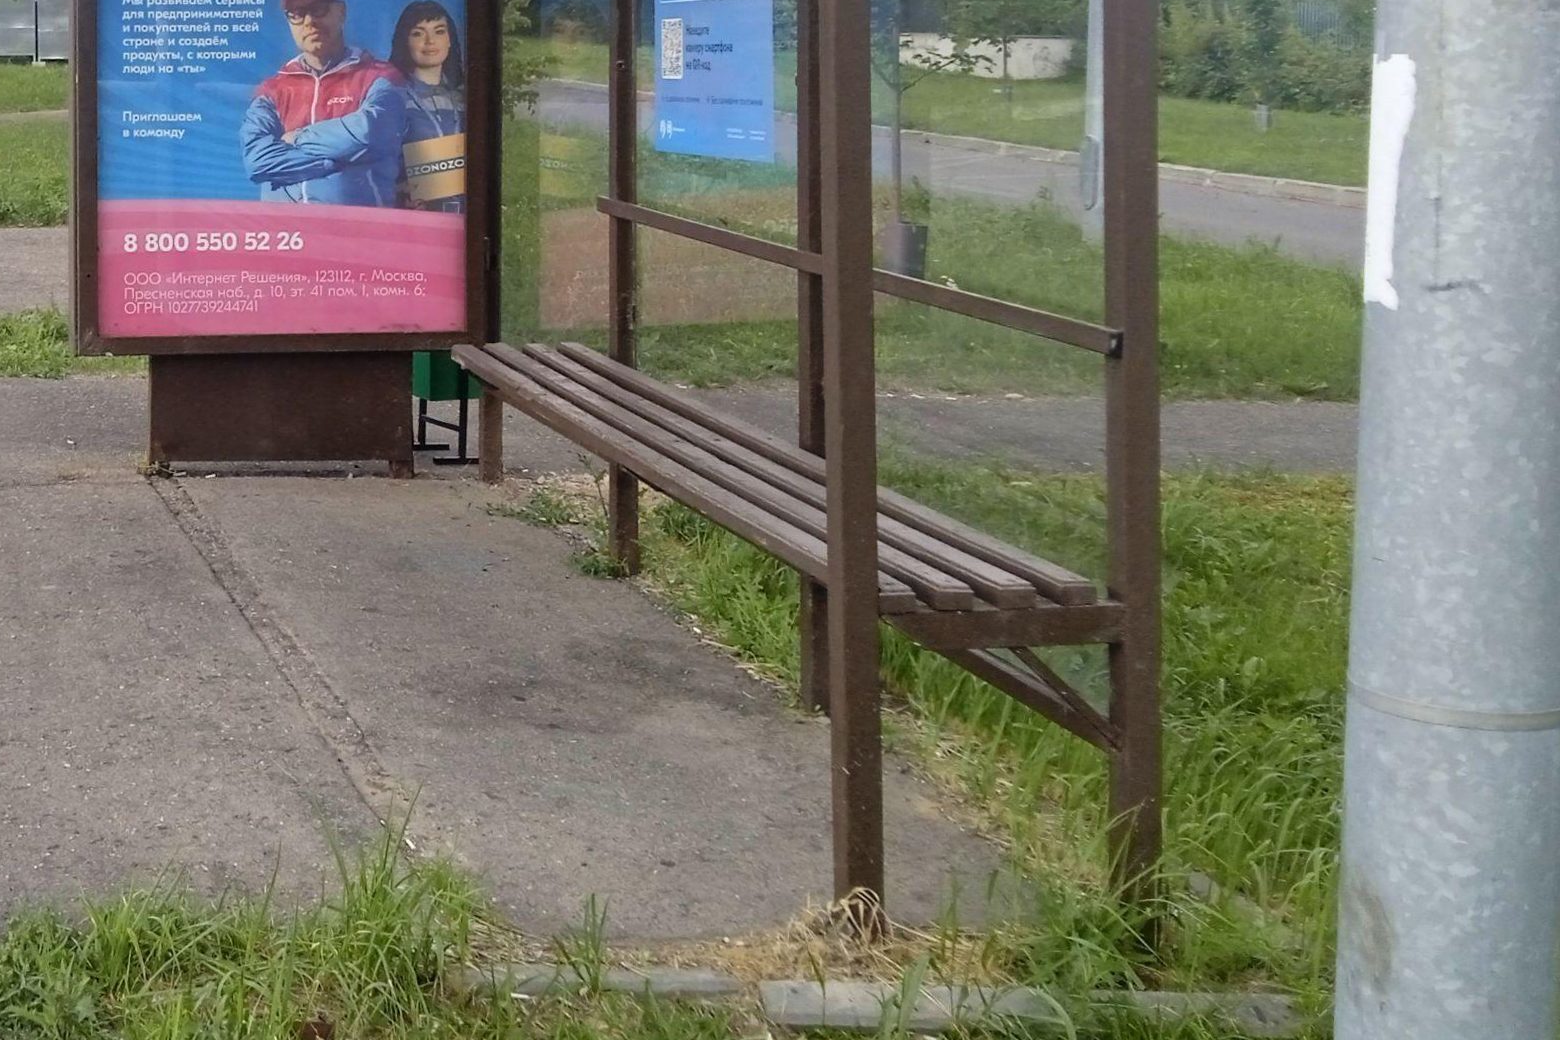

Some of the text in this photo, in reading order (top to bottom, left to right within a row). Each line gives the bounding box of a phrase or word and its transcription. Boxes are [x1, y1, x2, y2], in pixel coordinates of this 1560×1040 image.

[122, 8, 263, 22] для предпринимателей
[122, 22, 259, 34] и покупателей по всей
[122, 36, 228, 48] стране и создаём
[122, 50, 256, 62] продукты, с которыми
[122, 64, 206, 74] люди на «ты»
[122, 110, 202, 124] Приглашаем
[122, 129, 185, 139] в команду
[123, 231, 304, 252] 8 800 550 52 26
[123, 269, 428, 287] ООО «Интернет Решения», 123112, г. Москва,
[124, 287, 213, 302] Пресненская
[270, 285, 286, 299] 10,
[310, 285, 323, 297] 41
[328, 287, 357, 297] пом.
[373, 287, 410, 297] комн.
[124, 301, 163, 314] ОГРН
